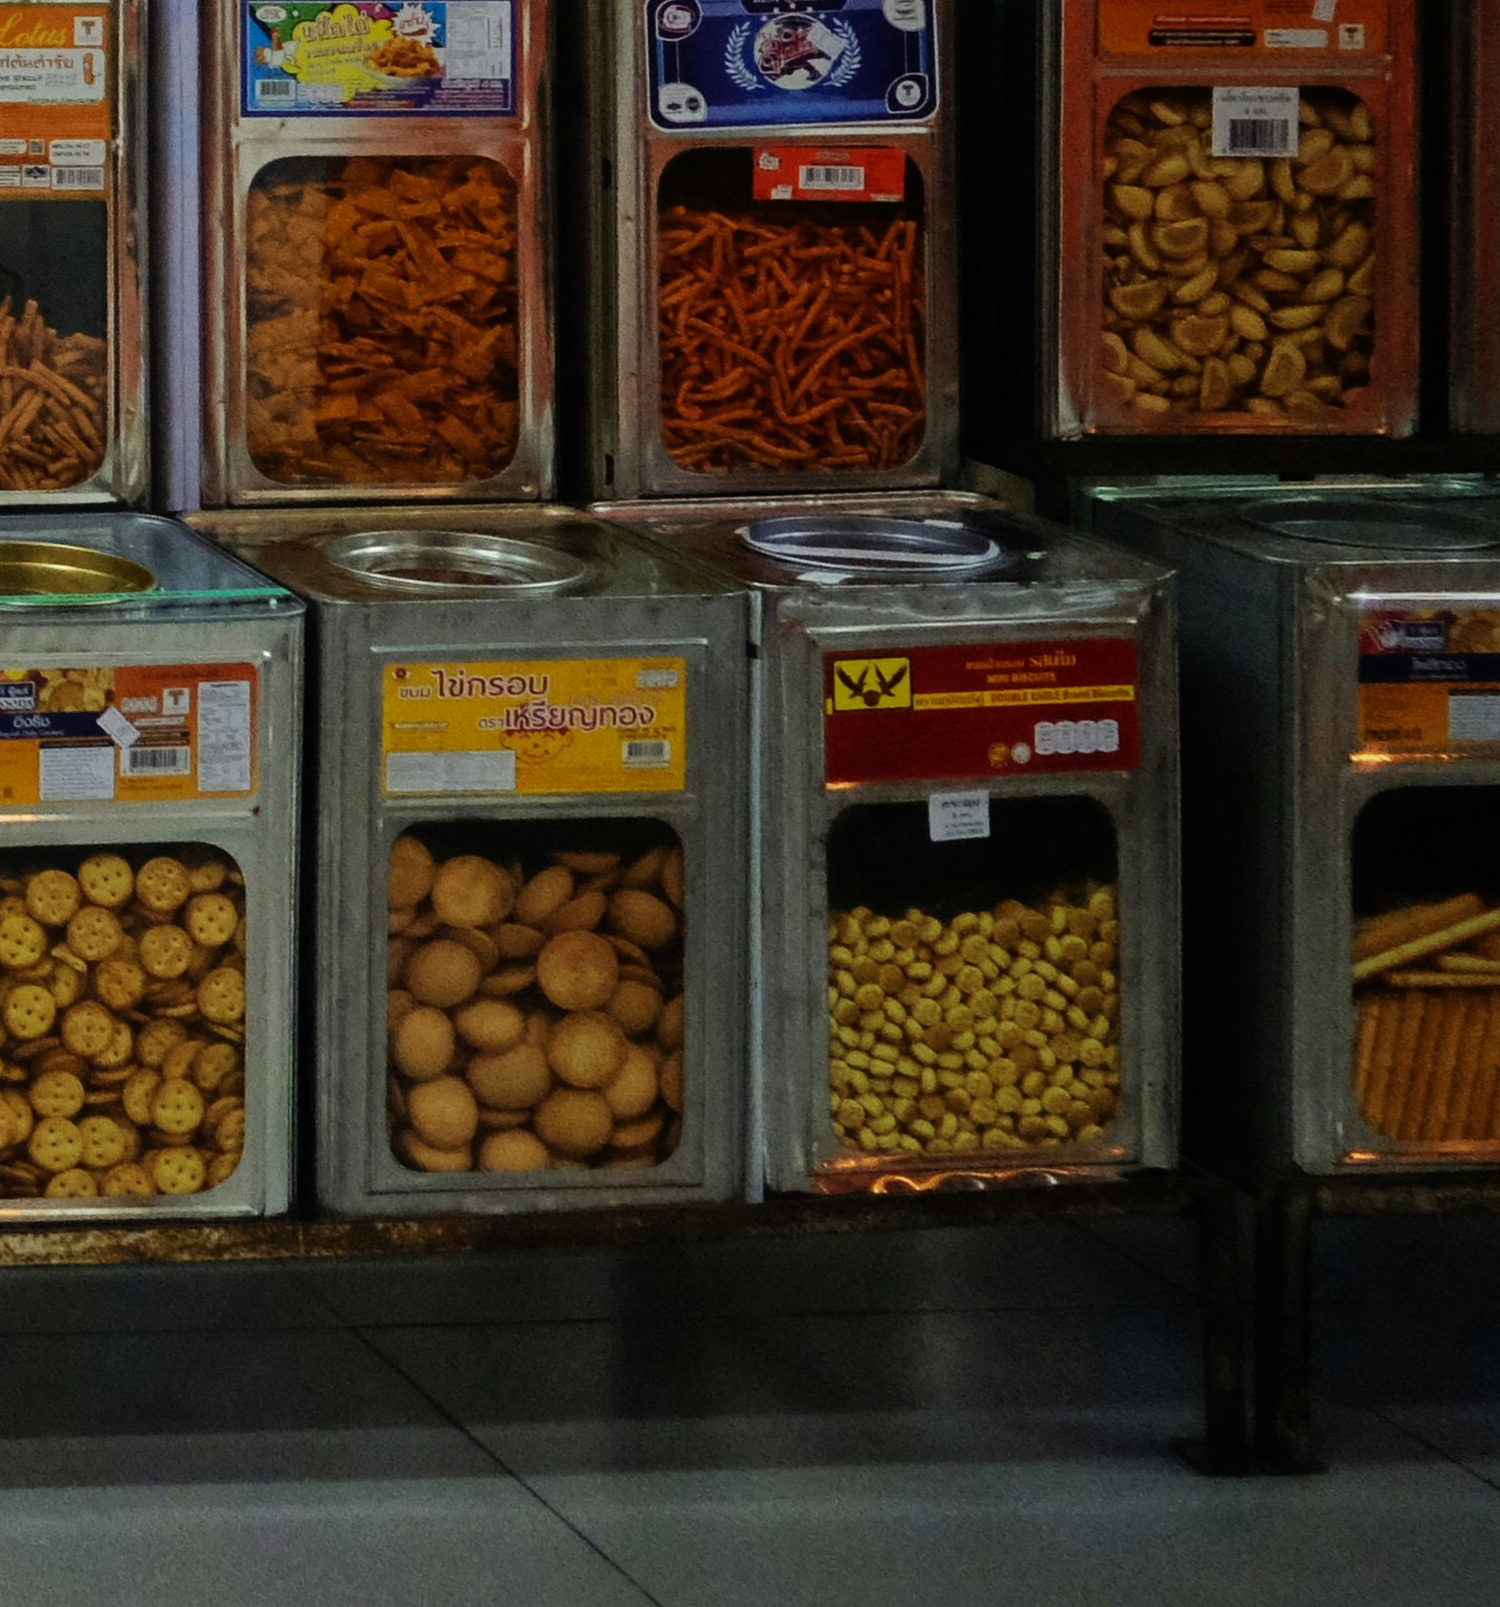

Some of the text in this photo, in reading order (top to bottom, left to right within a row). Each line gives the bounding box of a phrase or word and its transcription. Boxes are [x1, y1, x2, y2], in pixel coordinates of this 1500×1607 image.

[399, 667, 549, 700] ขนม ไข่กรอบ
[504, 701, 656, 732] เหรียญทอง
